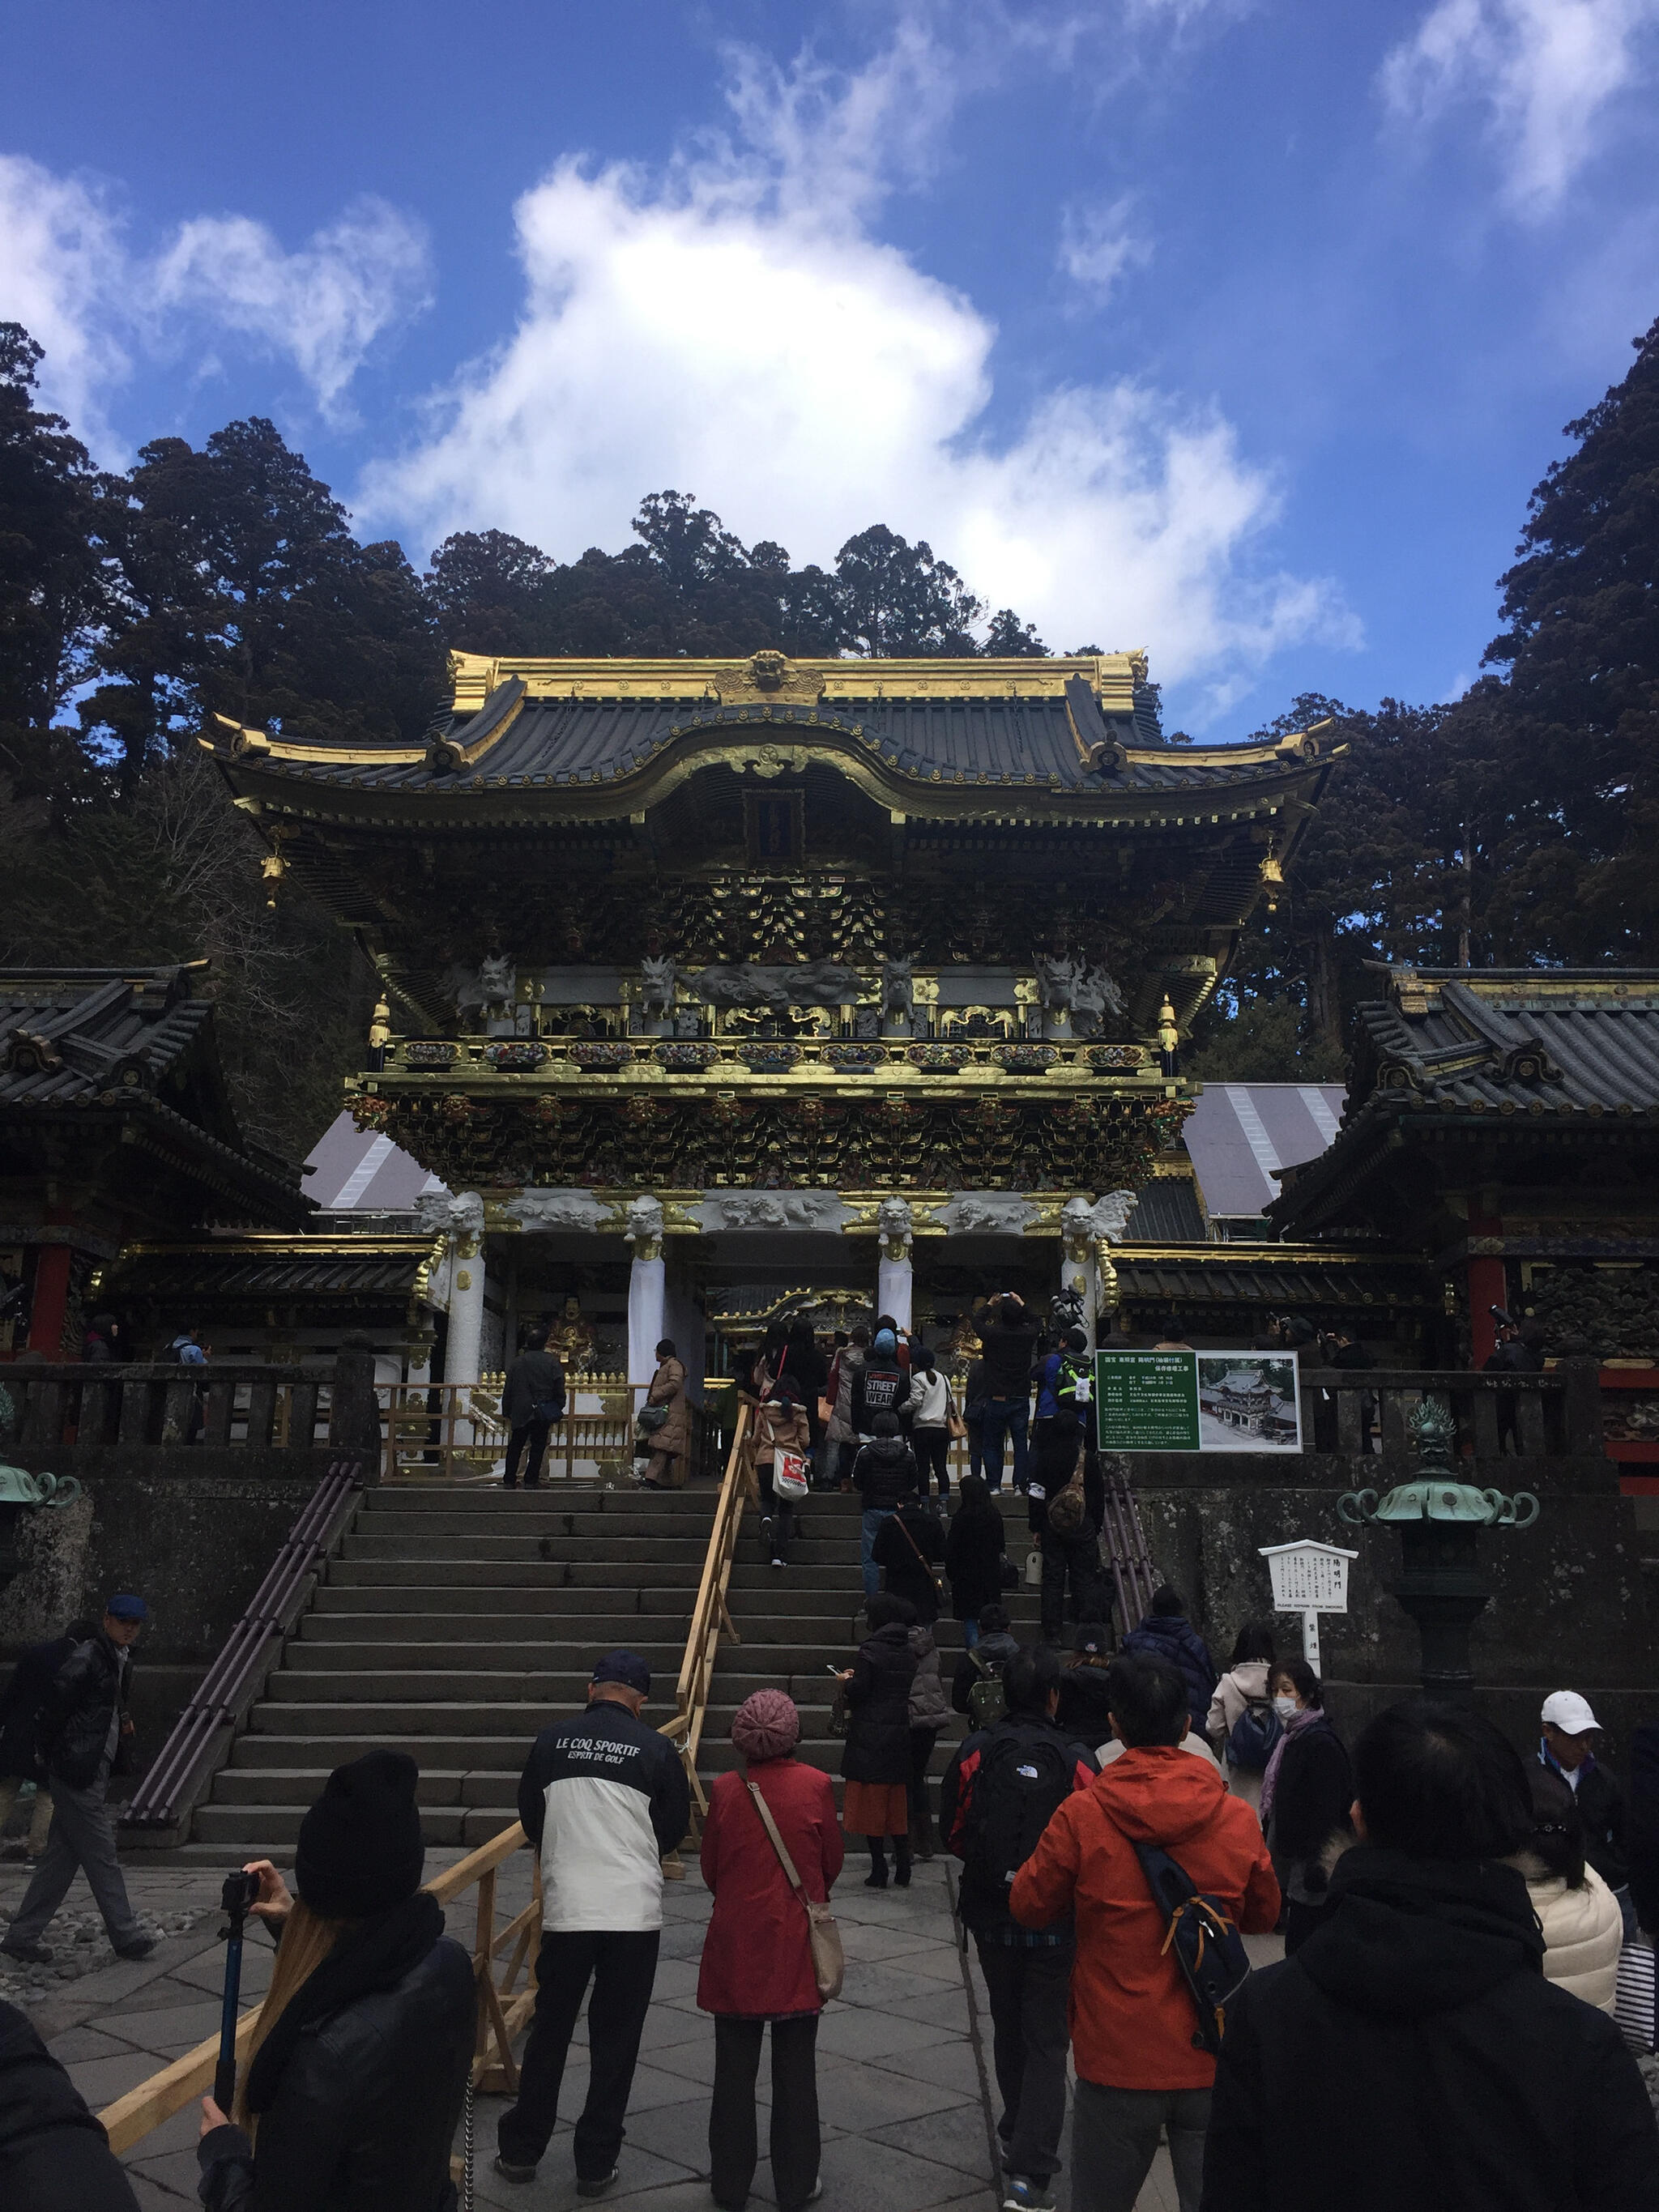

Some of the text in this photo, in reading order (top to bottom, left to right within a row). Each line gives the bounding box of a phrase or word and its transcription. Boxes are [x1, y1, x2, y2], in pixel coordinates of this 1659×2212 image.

[867, 1379, 897, 1392] STREET
[868, 1392, 893, 1404] WEAR
[1333, 1558, 1341, 1589] 陽明門
[556, 1737, 641, 1757] LE COQ SPORTIF
[567, 1750, 625, 1765] ESPRIT DE GOLF
